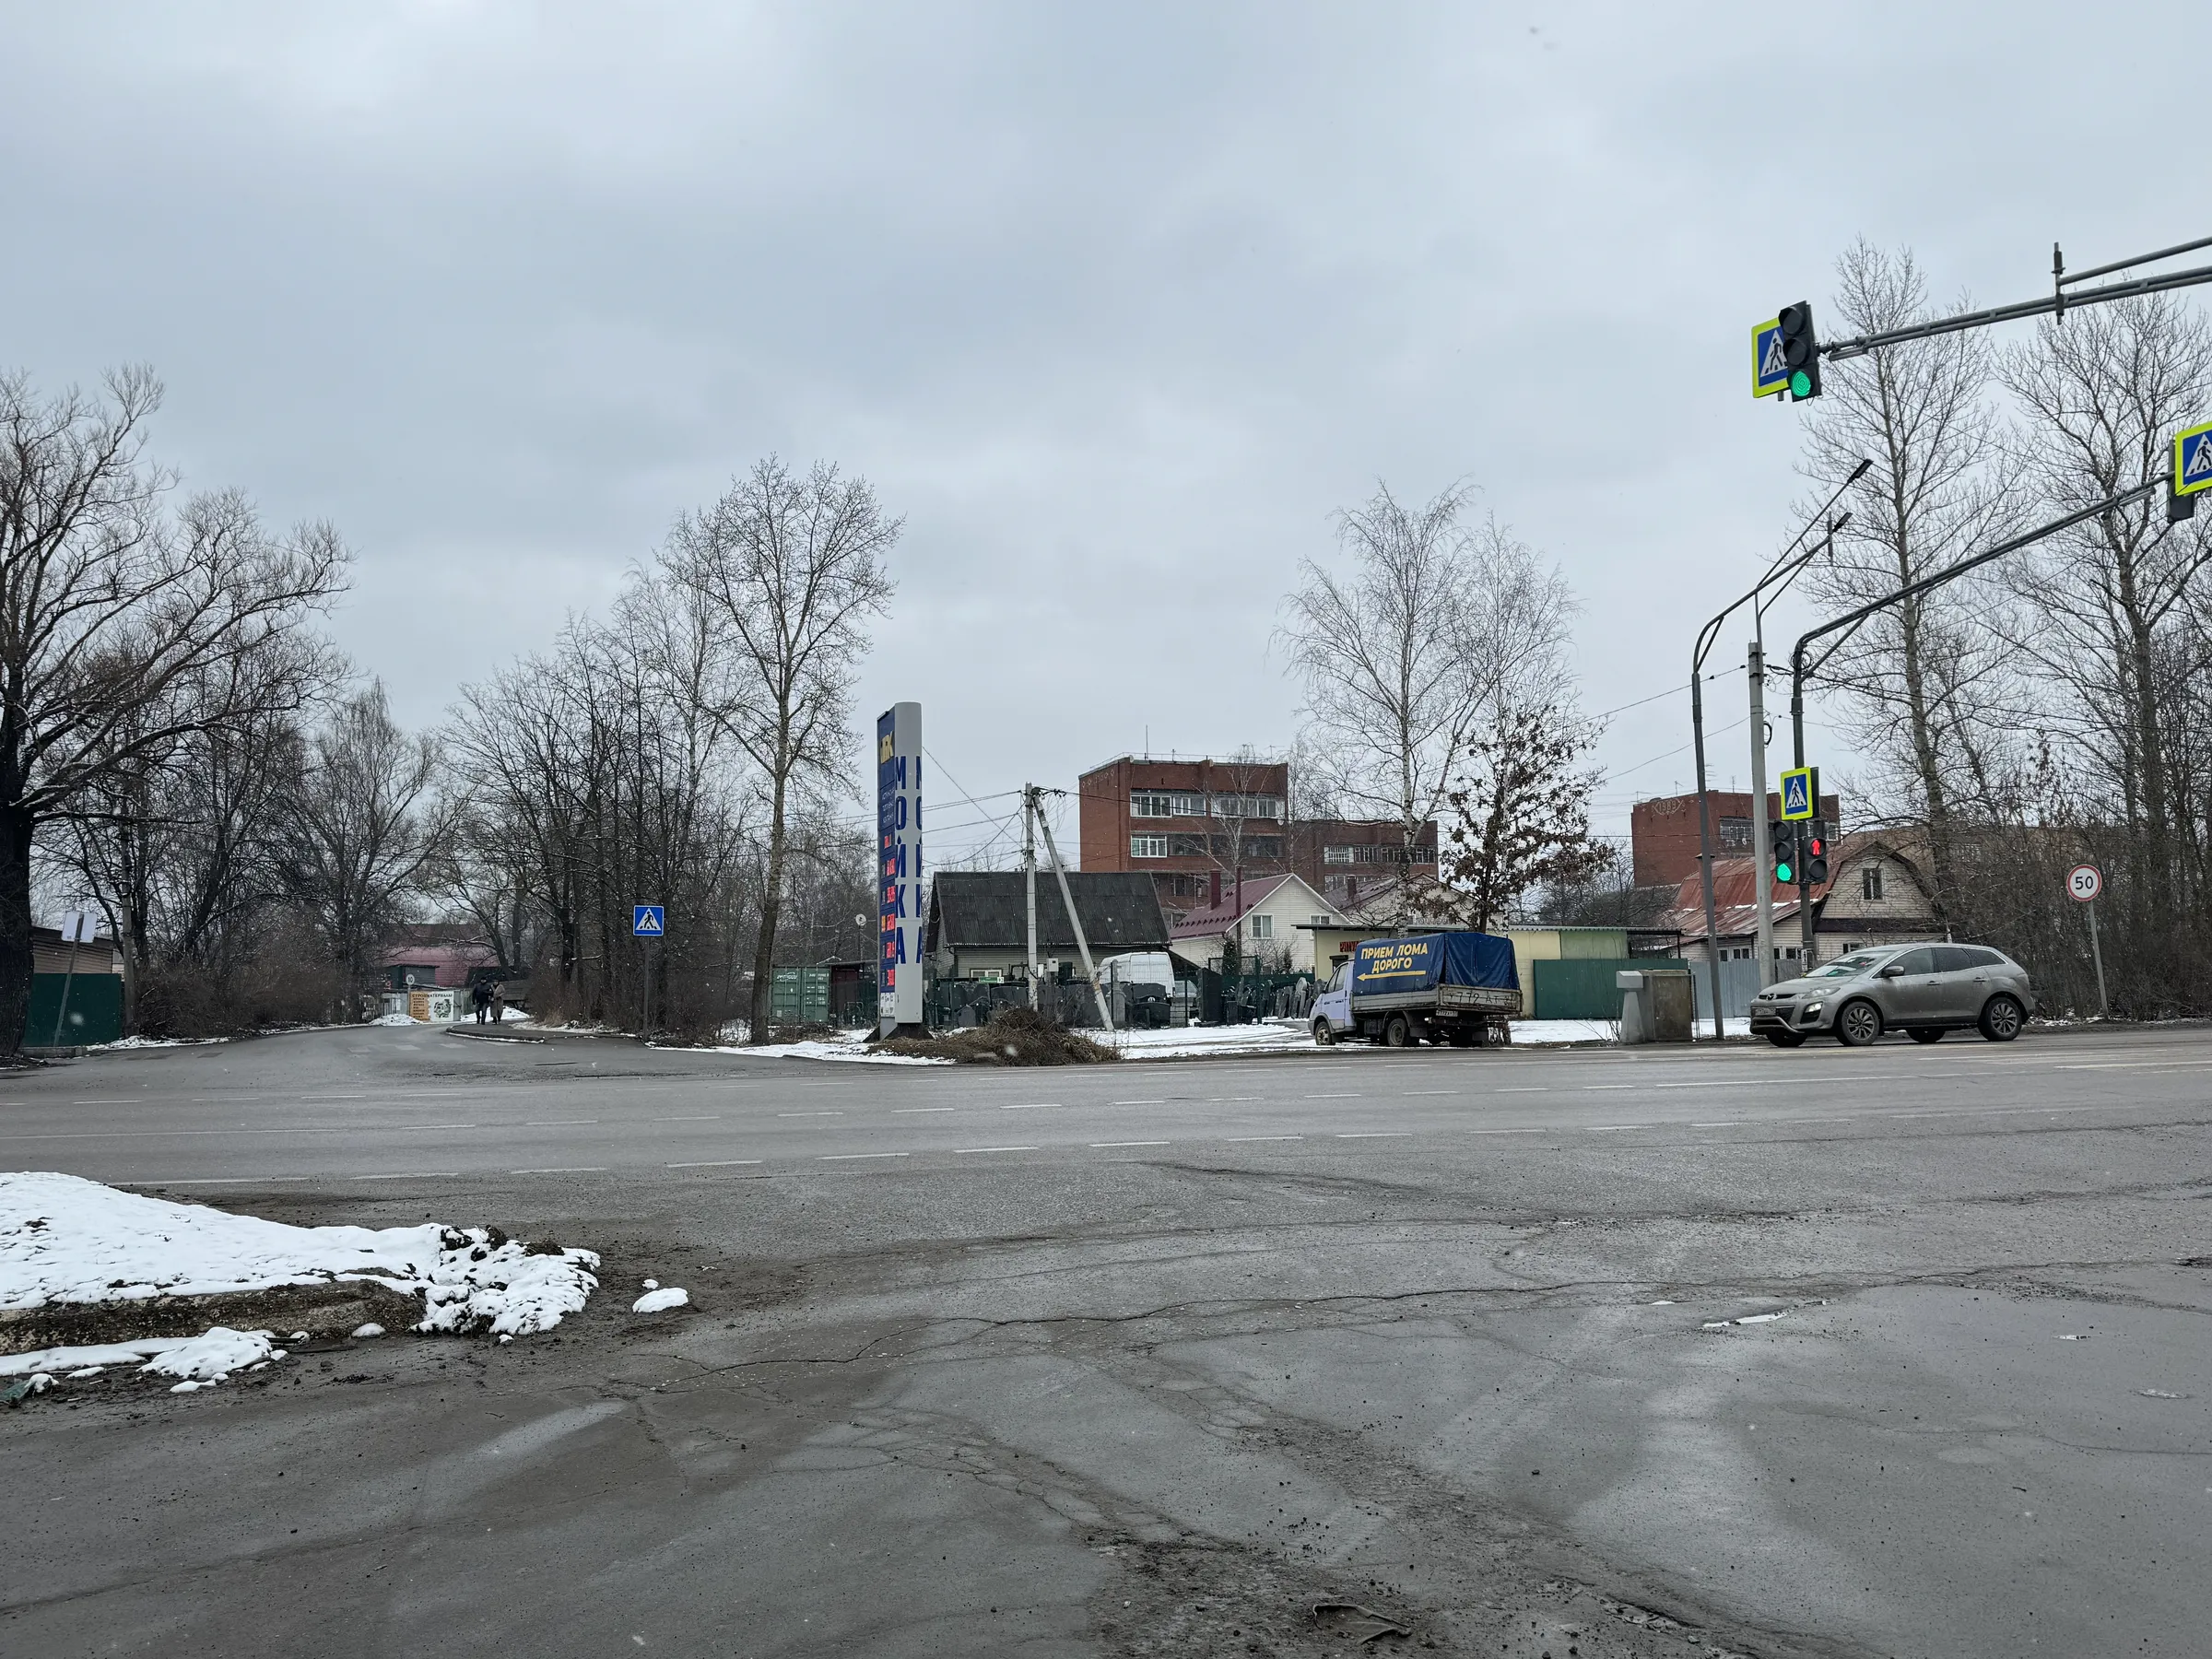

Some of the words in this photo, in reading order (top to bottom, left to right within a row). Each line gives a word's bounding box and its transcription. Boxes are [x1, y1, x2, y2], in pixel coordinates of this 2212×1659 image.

[895, 756, 906, 965] МОЙКА
[2075, 876, 2094, 890] 50
[1360, 946, 1394, 960] ПРИЕМ
[1396, 942, 1429, 957] ЛОМА
[1371, 957, 1413, 974] ДОРОГО
